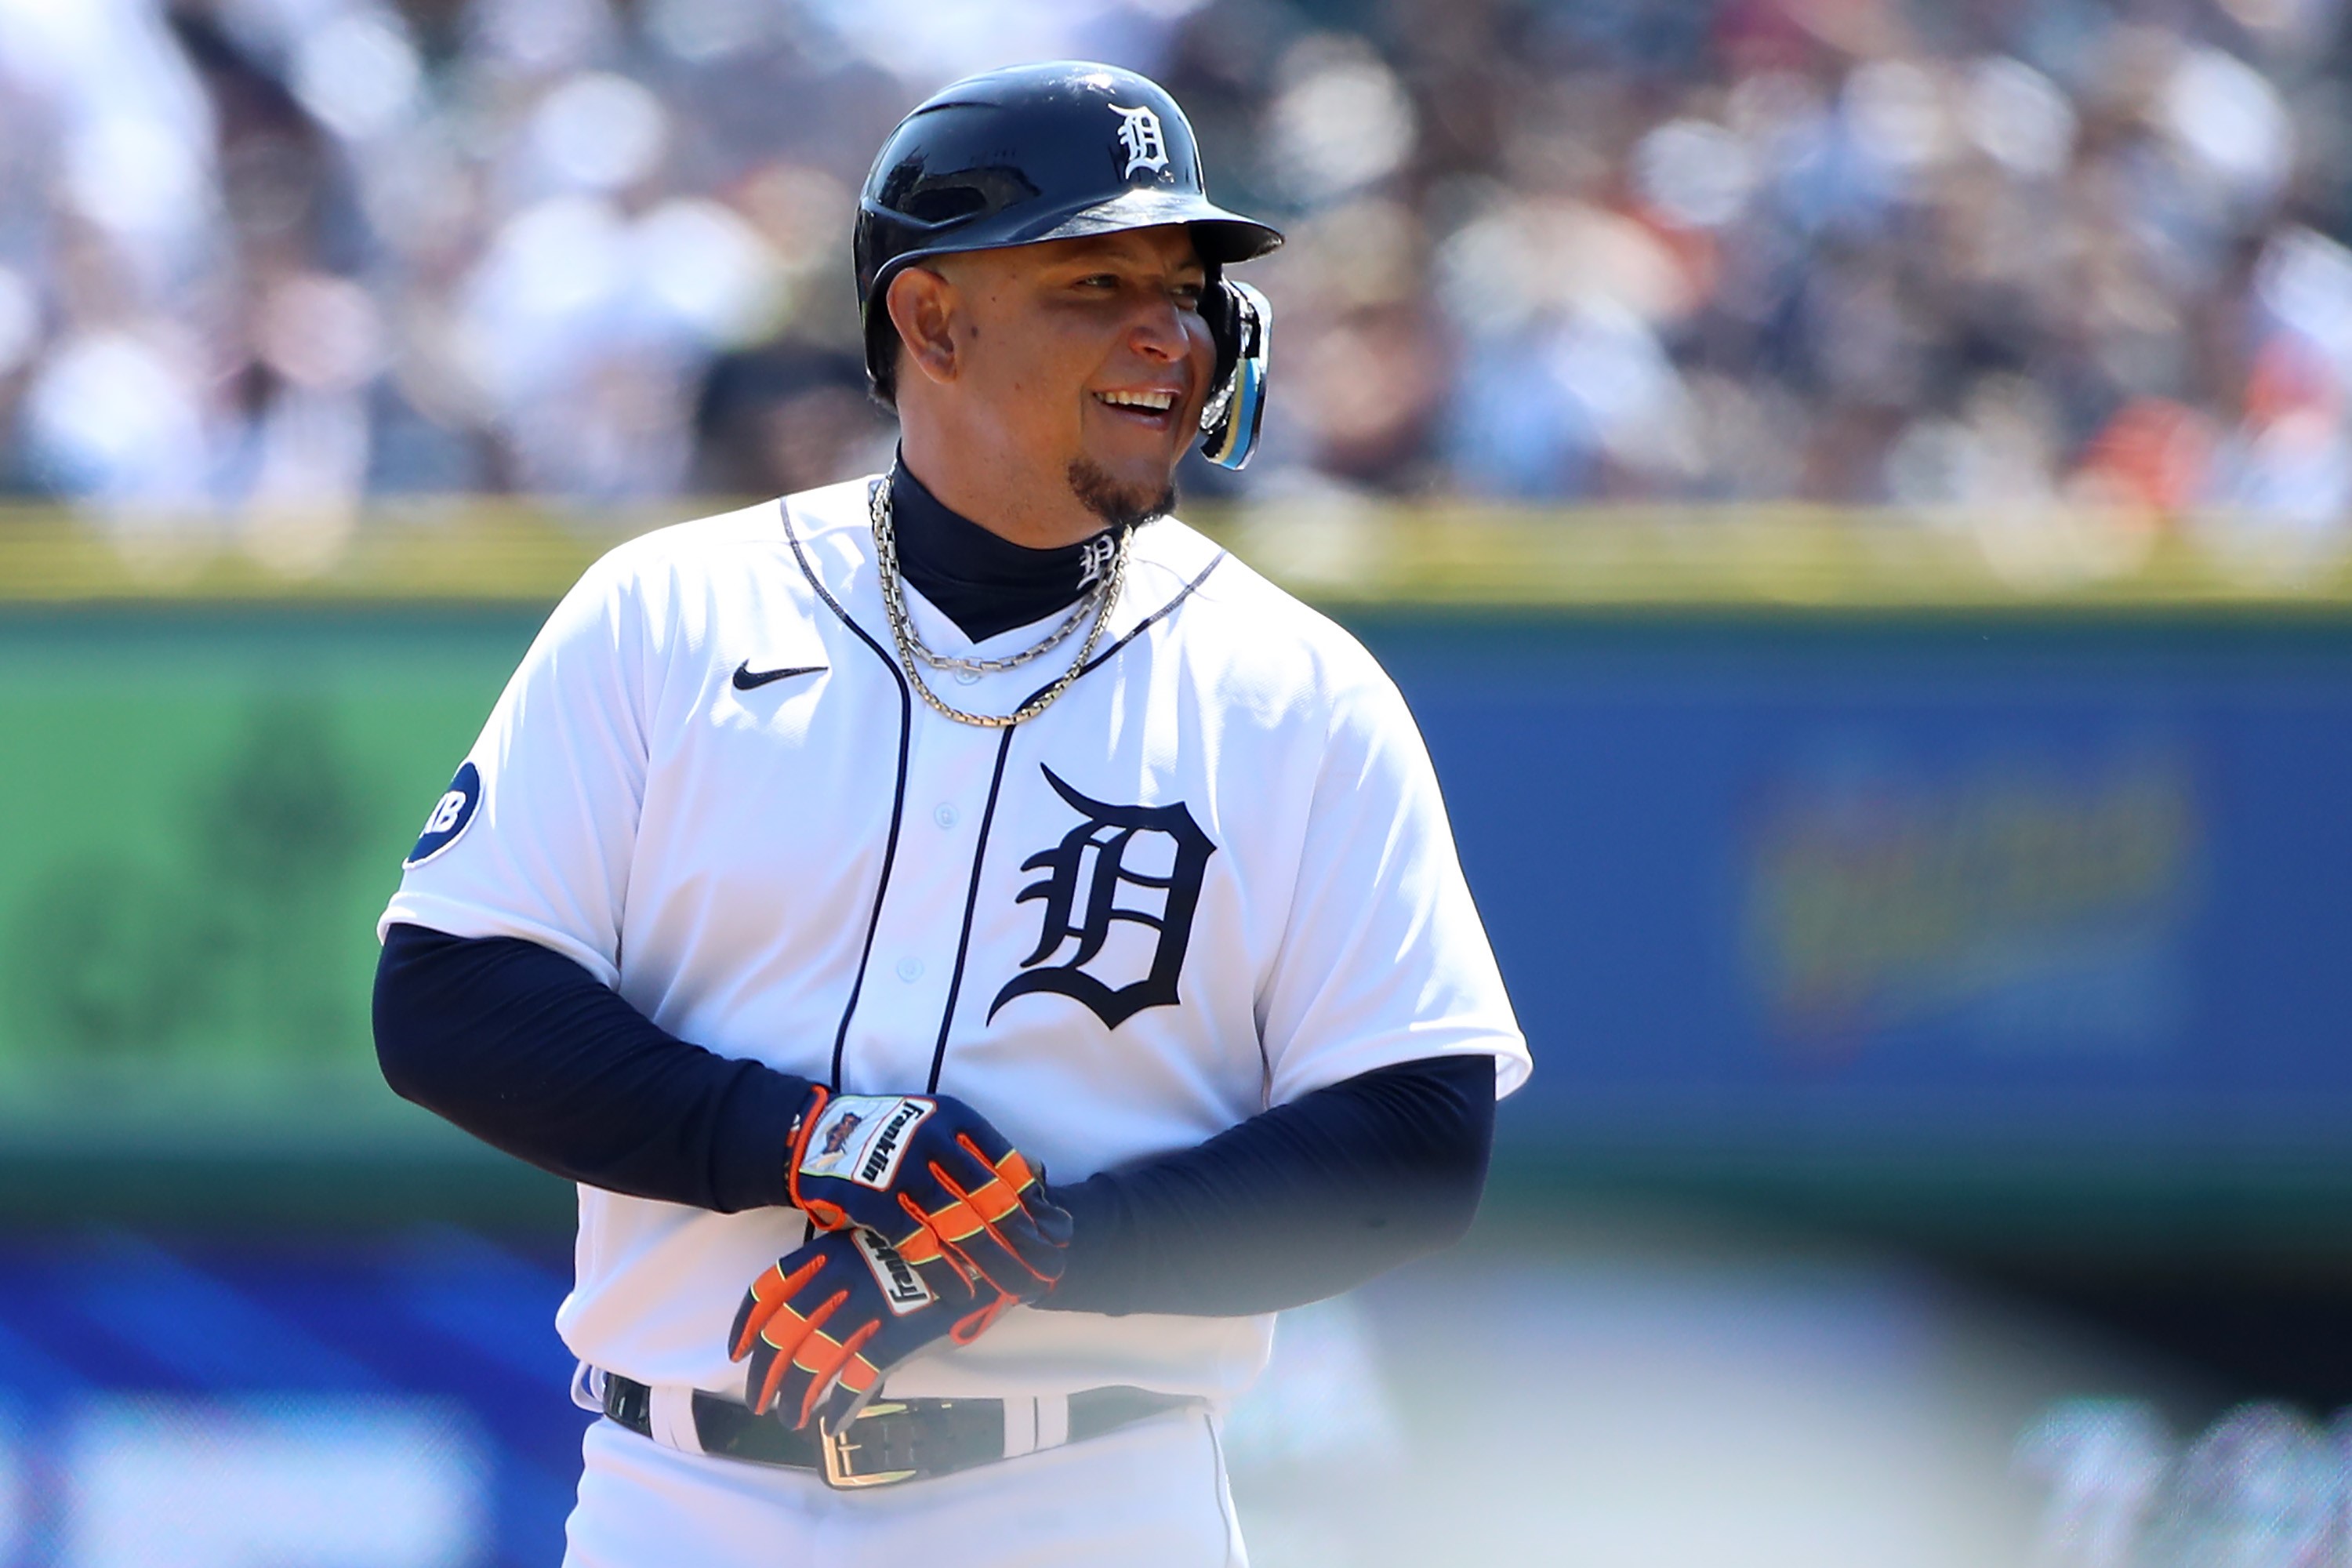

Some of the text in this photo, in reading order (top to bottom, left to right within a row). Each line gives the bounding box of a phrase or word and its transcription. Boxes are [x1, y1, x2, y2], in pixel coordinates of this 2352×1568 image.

[1108, 103, 1169, 180] D
[986, 762, 1217, 1030] D
[861, 1101, 924, 1182] Franklin
